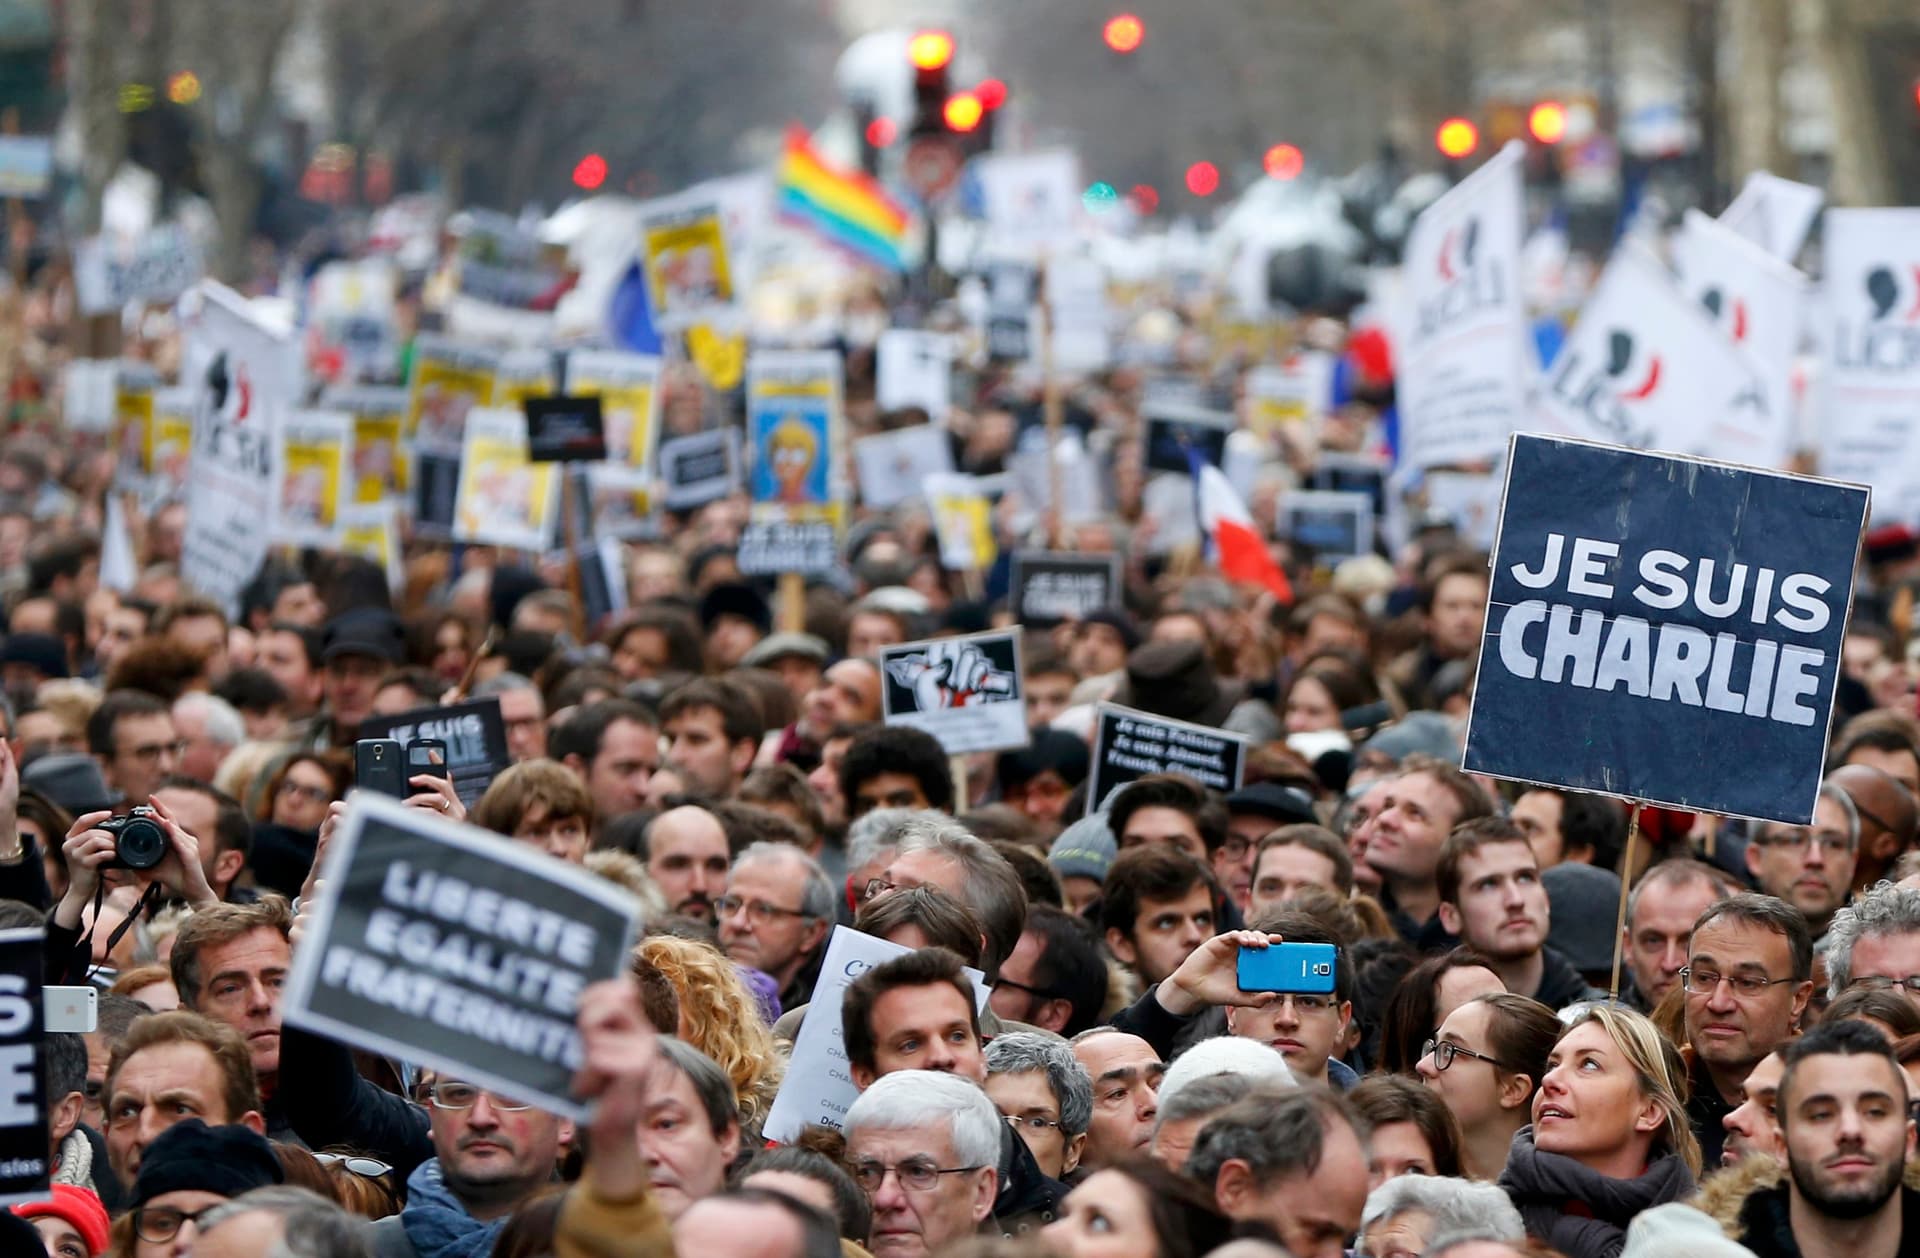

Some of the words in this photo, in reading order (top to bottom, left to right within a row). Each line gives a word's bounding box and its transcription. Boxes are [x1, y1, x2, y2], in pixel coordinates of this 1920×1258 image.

[1510, 533, 1621, 599] JE
[1632, 549, 1832, 633] SUIS
[1499, 599, 1826, 727] CHARLIE
